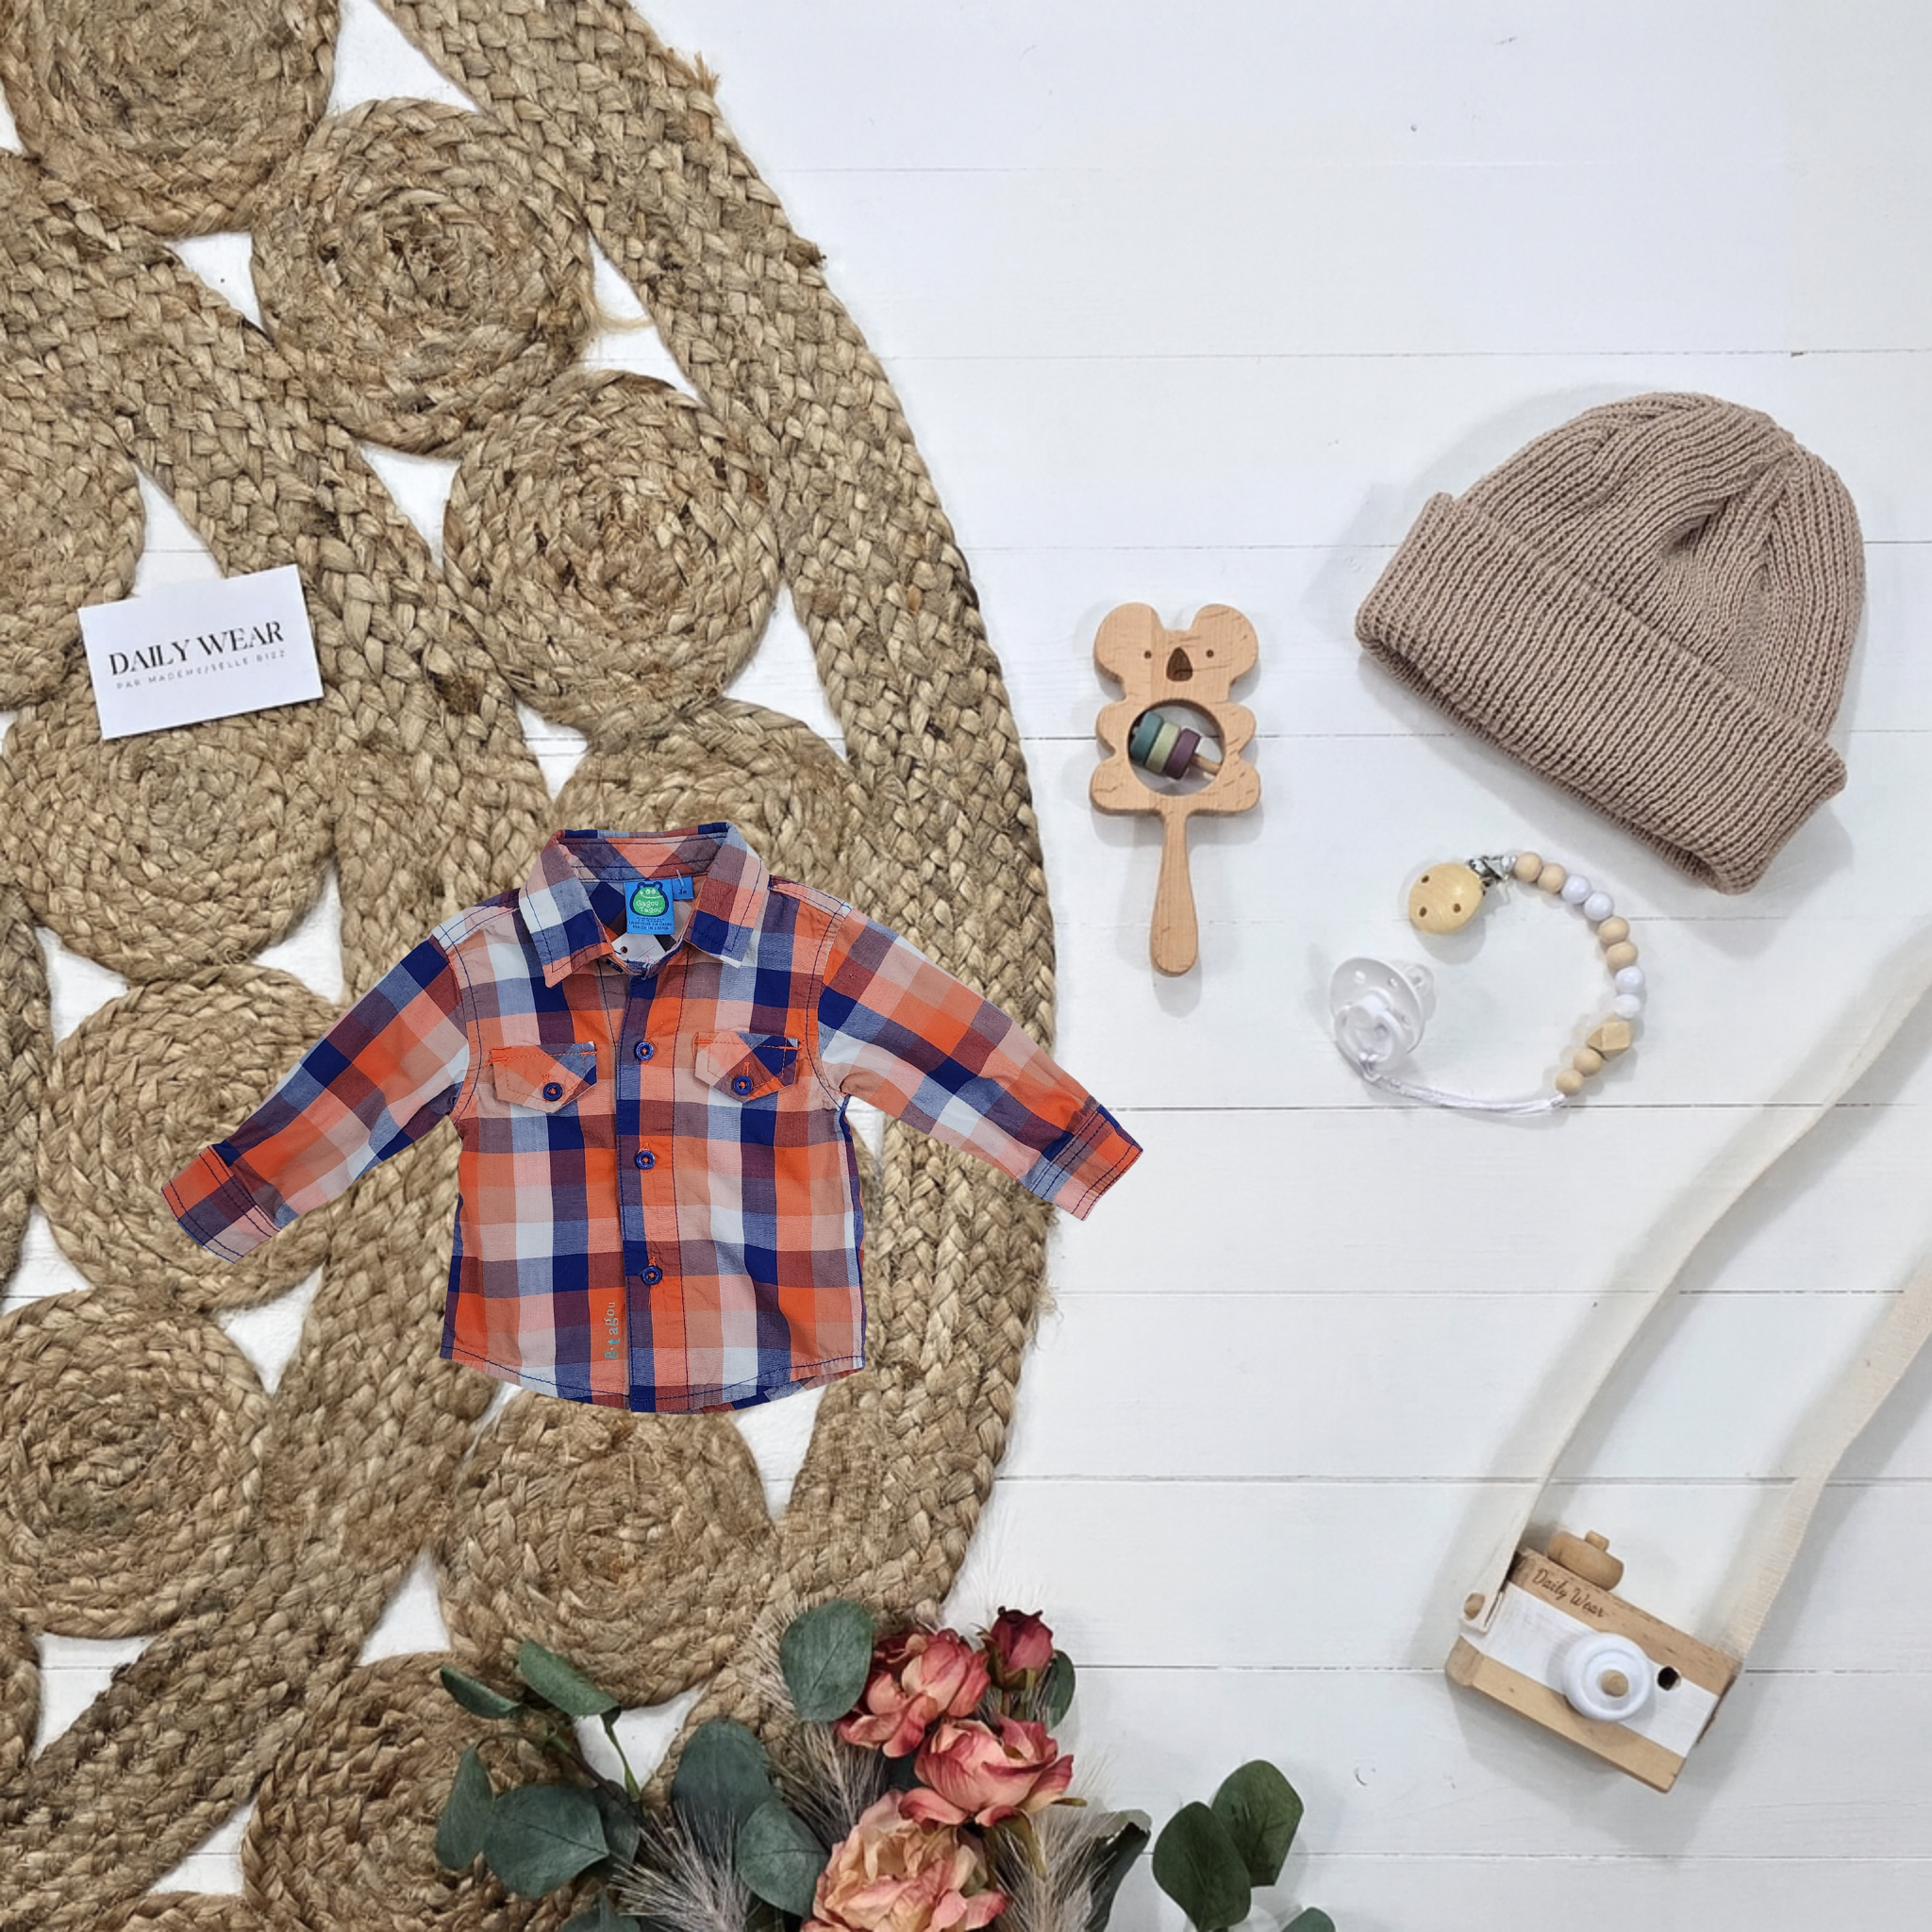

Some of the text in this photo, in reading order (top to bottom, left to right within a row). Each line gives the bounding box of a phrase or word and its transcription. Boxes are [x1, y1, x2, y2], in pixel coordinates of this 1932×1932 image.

[108, 620, 285, 676] DAILY WEAR
[116, 678, 142, 691] PAR
[635, 899, 659, 908] Gagou
[1531, 1568, 1569, 1601] Daily
